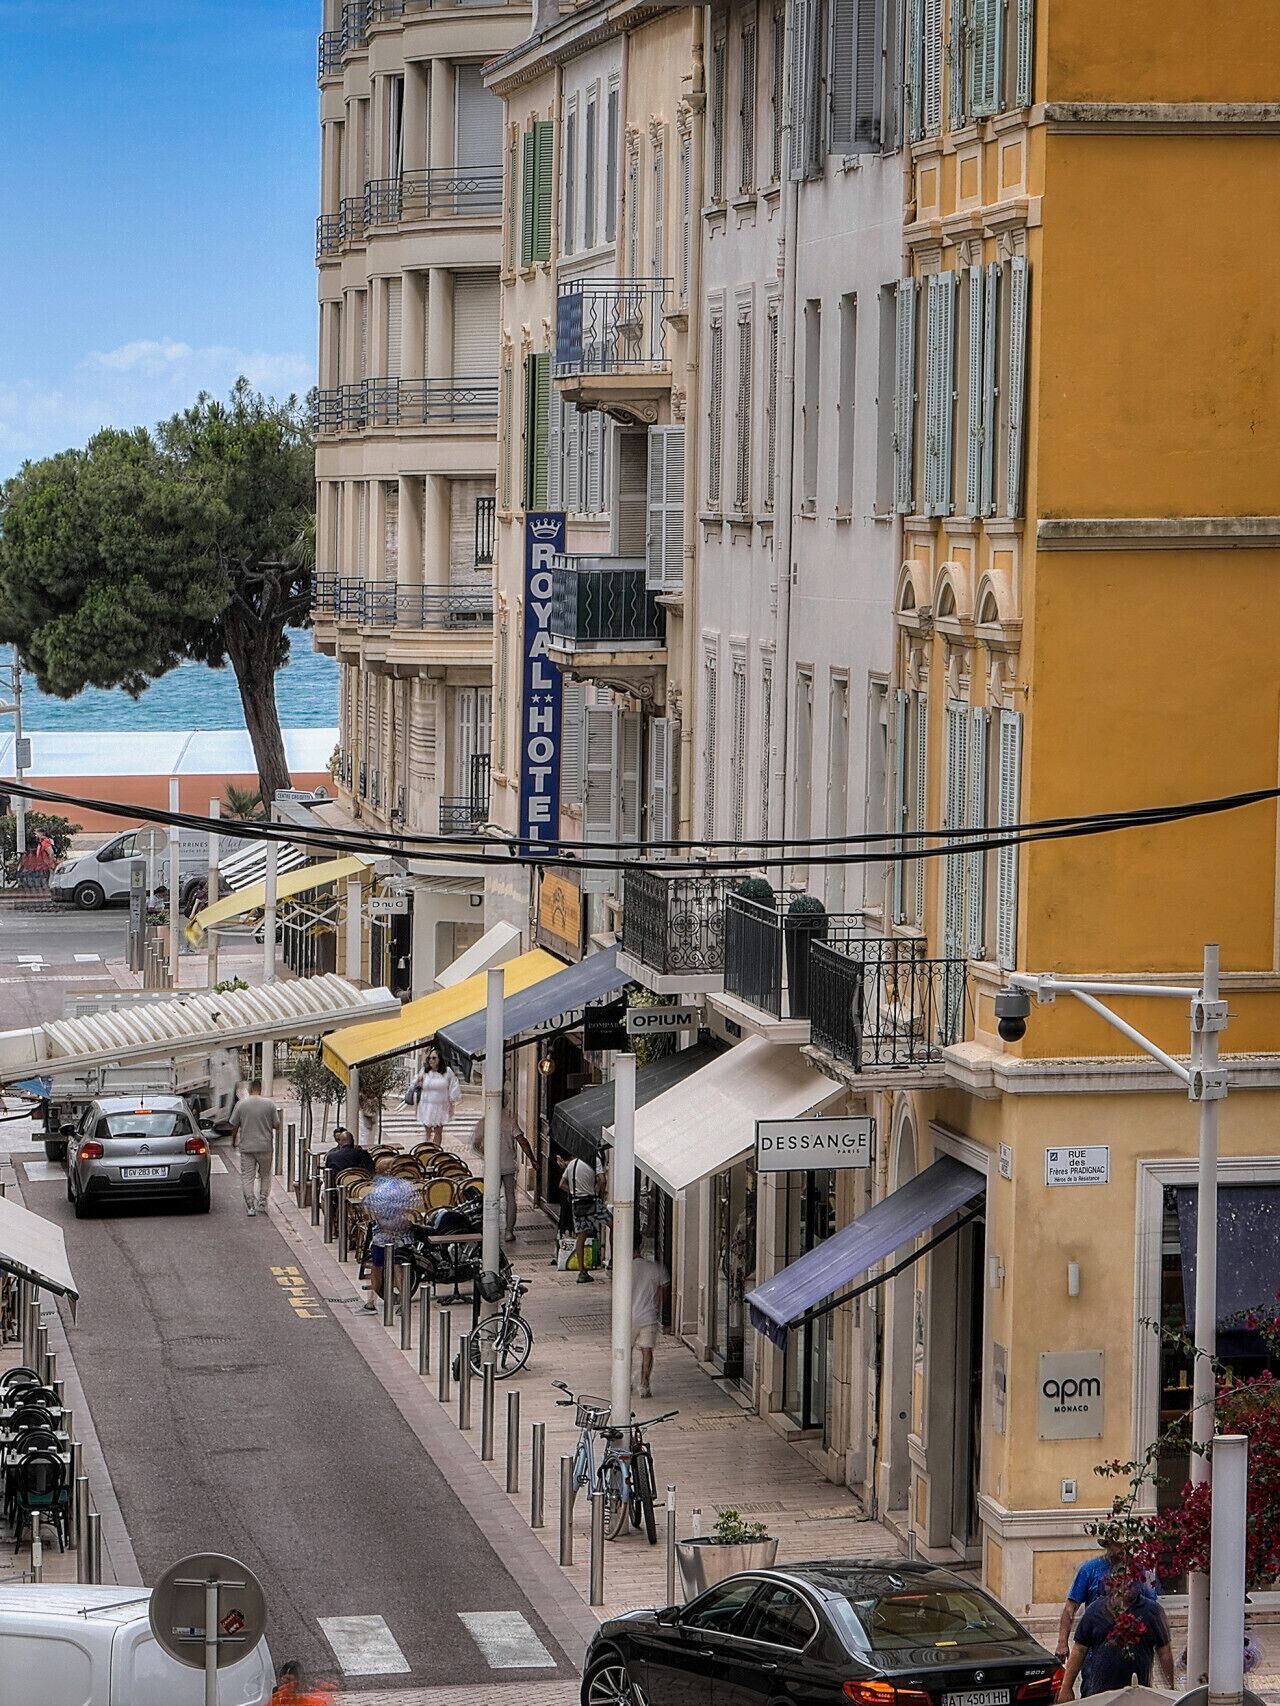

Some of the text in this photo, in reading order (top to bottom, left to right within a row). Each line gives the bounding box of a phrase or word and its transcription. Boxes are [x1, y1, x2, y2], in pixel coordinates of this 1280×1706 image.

[529, 543, 554, 689] ROYAL
[528, 706, 554, 852] HOTEL
[632, 1013, 692, 1027] OPIUM
[761, 1133, 866, 1150] DESSANGE
[1068, 1150, 1086, 1158] RUE
[1049, 1166, 1105, 1175] Frères PRADIGNAC
[1043, 1378, 1101, 1405] apm
[967, 1693, 991, 1705] 4501
[993, 1691, 1009, 1703] HH
